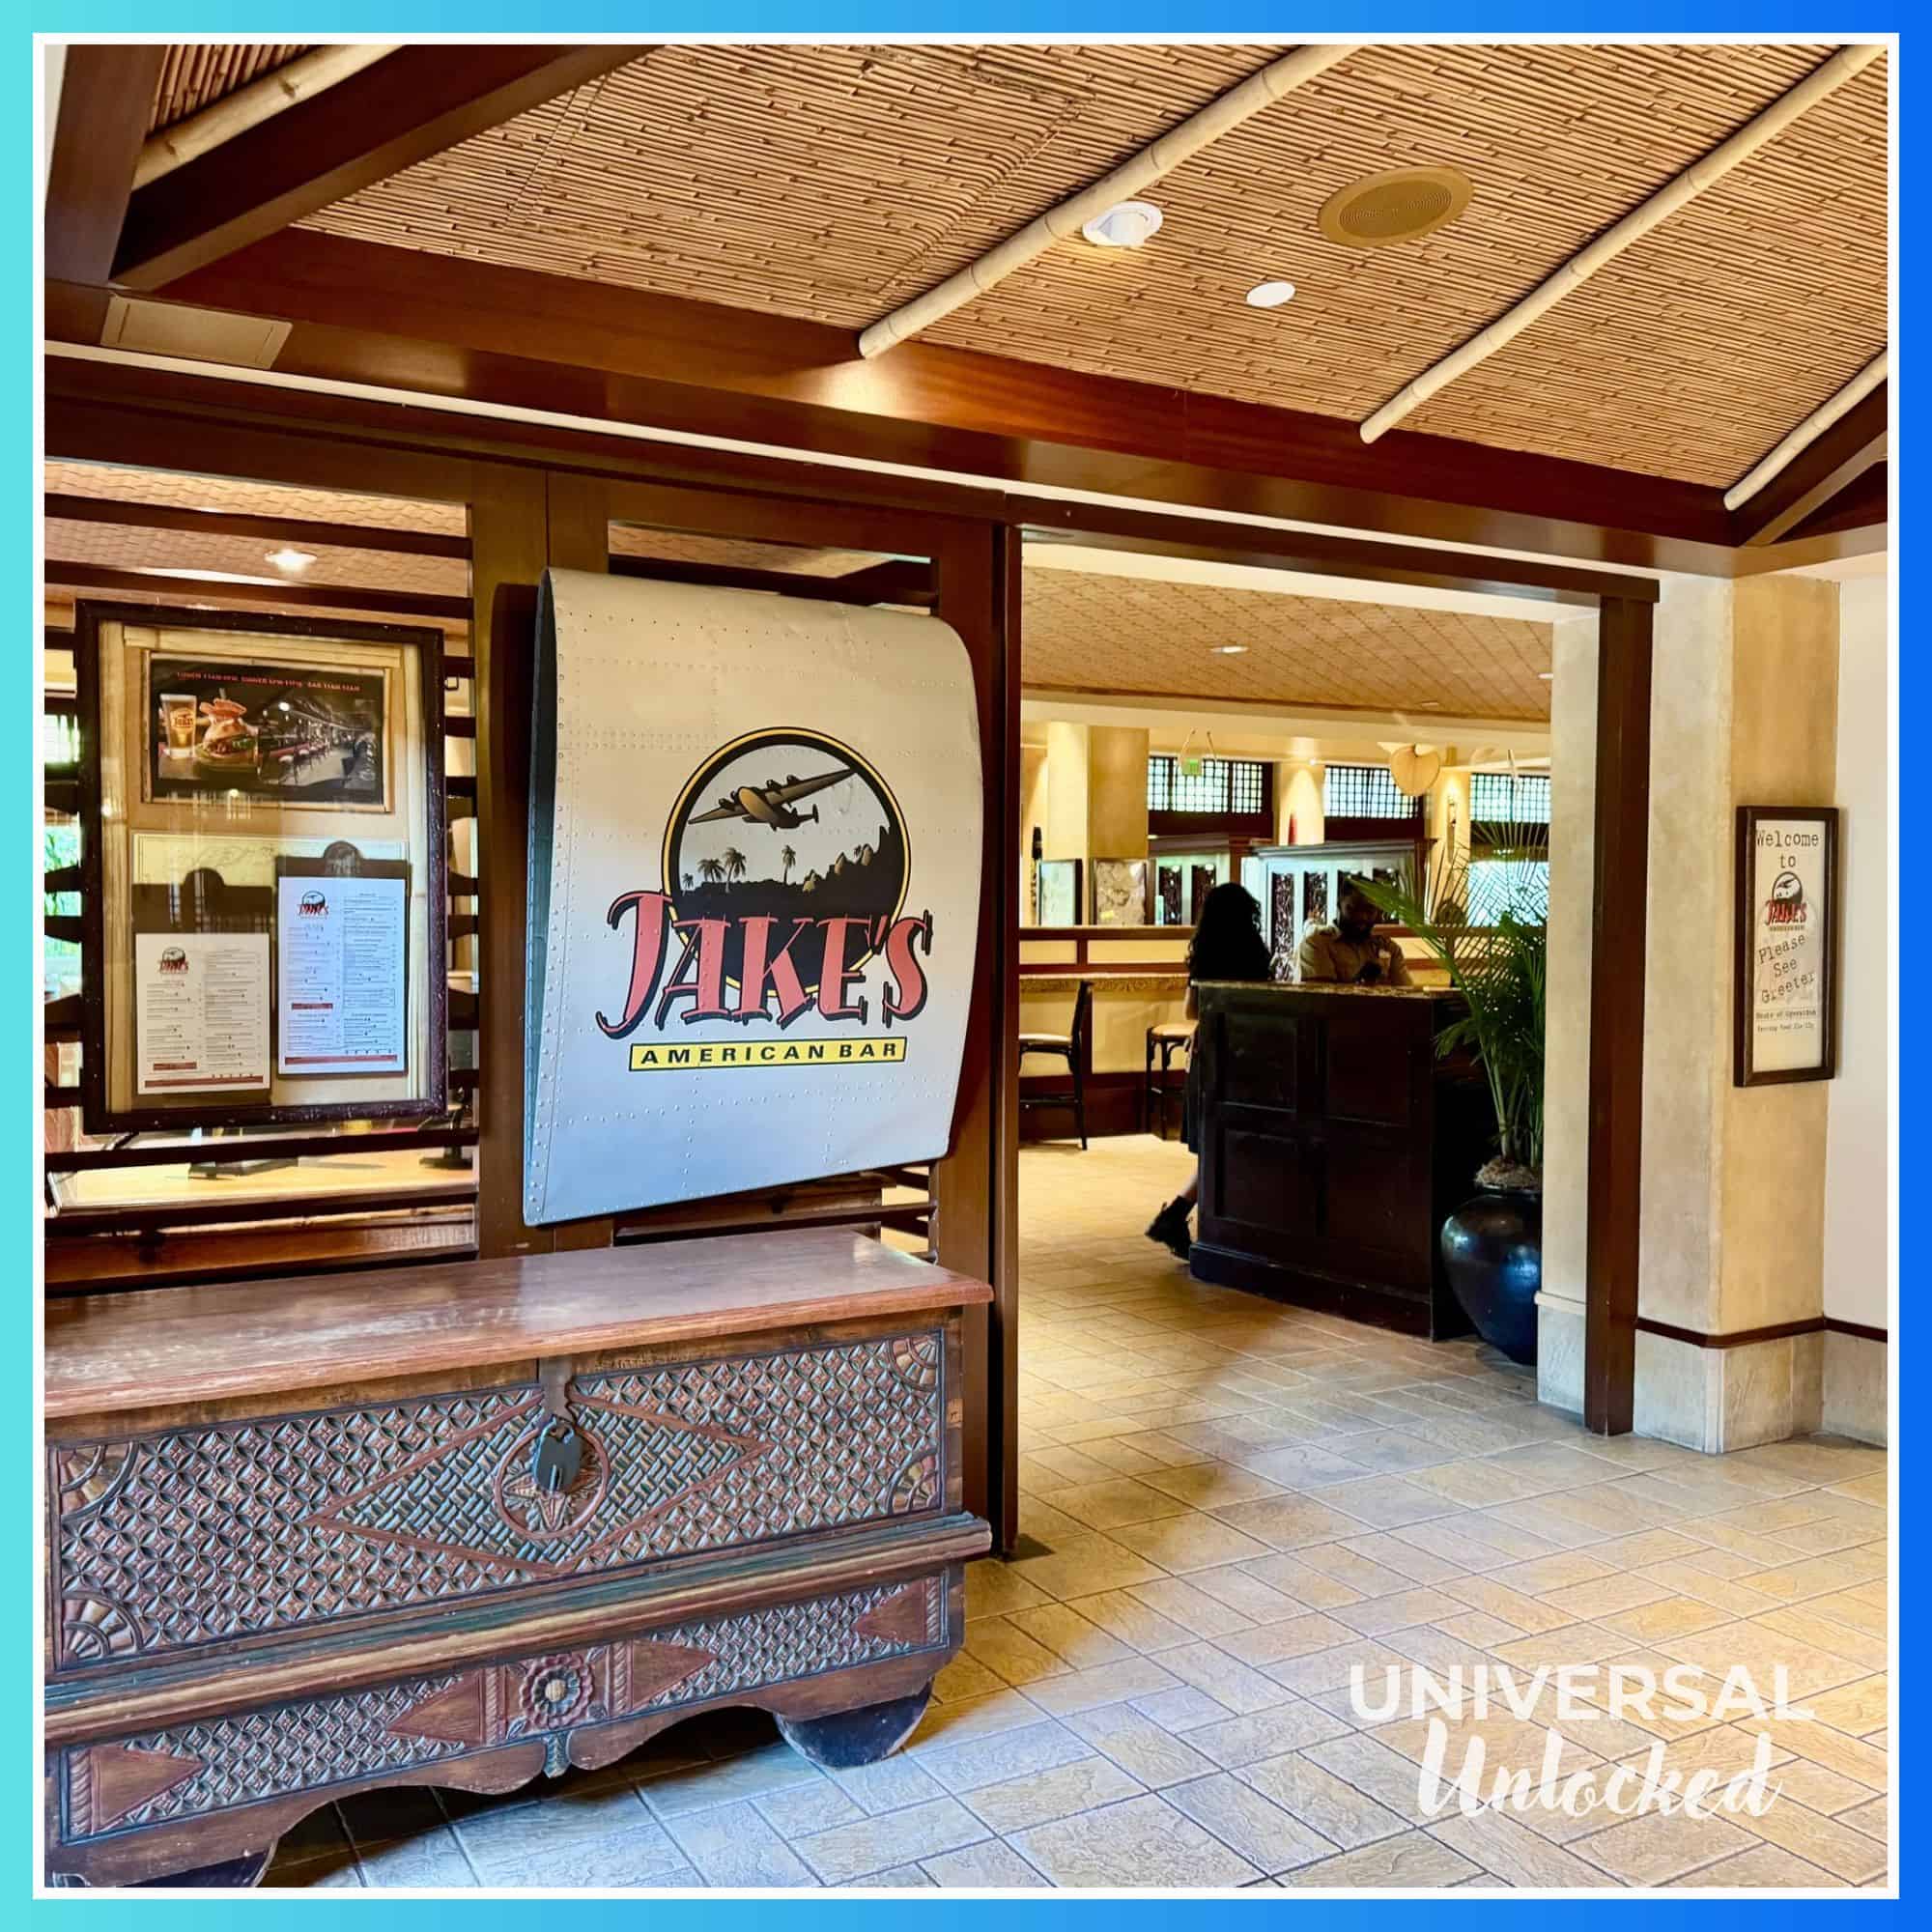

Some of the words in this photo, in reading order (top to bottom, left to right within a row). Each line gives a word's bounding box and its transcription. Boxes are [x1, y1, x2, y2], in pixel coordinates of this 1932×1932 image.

[1755, 830, 1820, 847] Welcome
[1779, 853, 1797, 868] to
[1758, 934, 1805, 964] Please
[595, 889, 933, 1039] JAKE'S
[1773, 958, 1798, 979] See
[1761, 972, 1815, 1004] Greeter
[640, 1043, 825, 1065] AMERICAN
[838, 1042, 897, 1059] BAR
